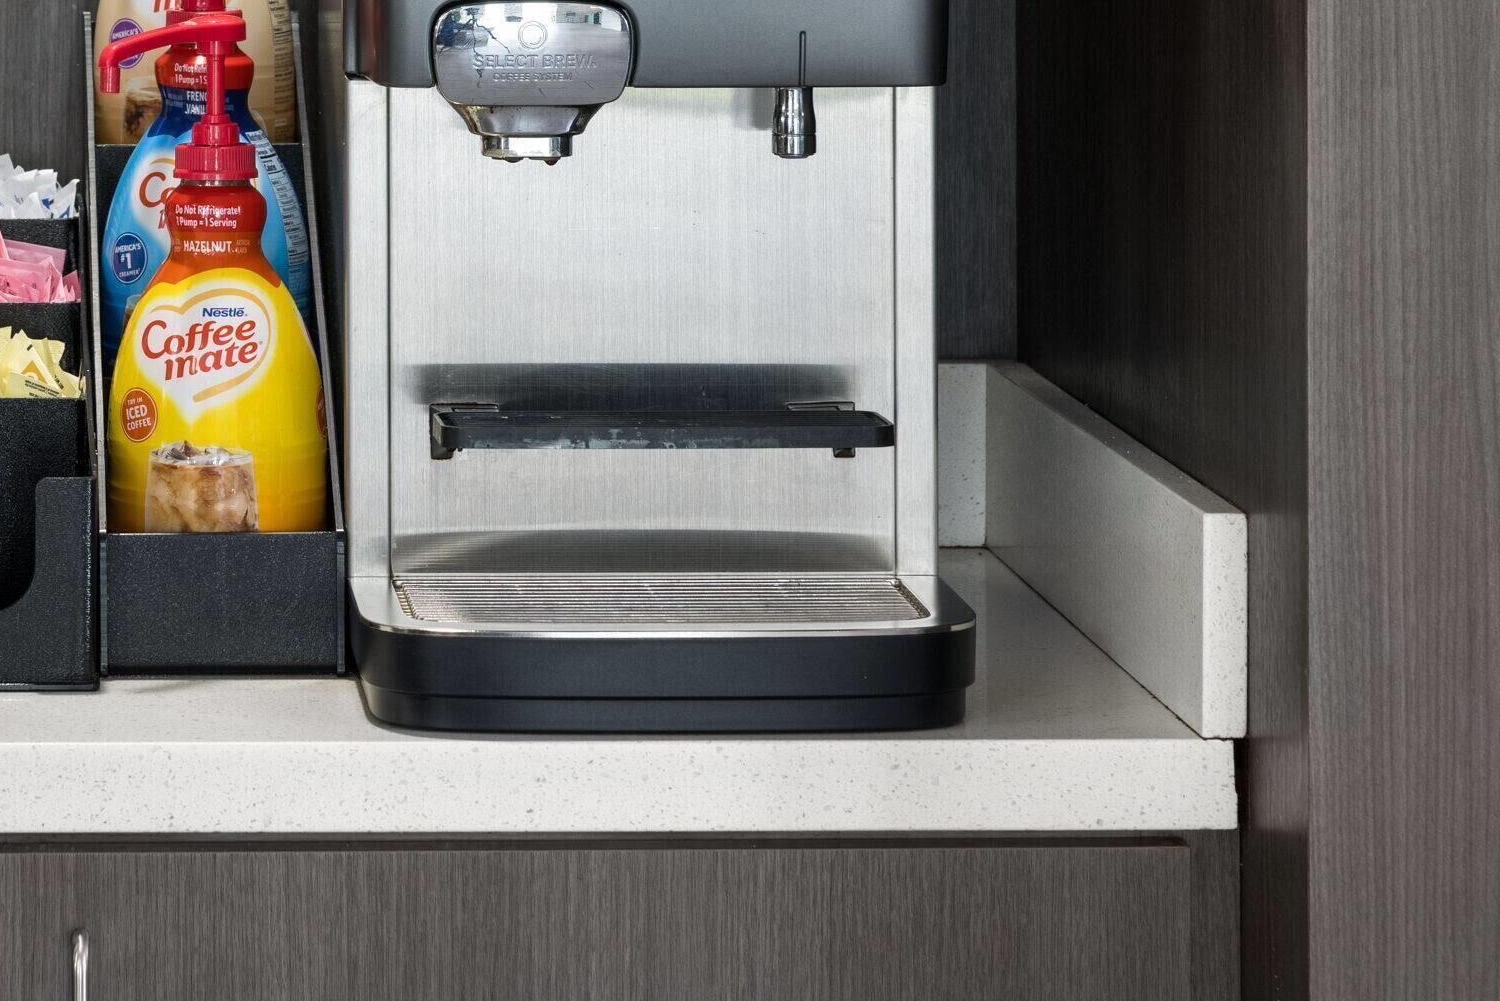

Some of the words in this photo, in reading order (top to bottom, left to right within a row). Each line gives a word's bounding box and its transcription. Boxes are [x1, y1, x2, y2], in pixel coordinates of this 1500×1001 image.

[473, 54, 539, 69] SELECT
[178, 74, 195, 85] Pump
[493, 72, 530, 82] COFFEE
[531, 72, 572, 82] SYSTEM
[175, 204, 183, 214] Do
[184, 204, 197, 215] Not
[180, 216, 198, 228] Pump
[209, 216, 237, 229] Serving
[114, 243, 142, 254] AMERICA'S
[183, 240, 232, 253] HAZELNUT
[202, 307, 245, 318] Nestlé
[141, 319, 256, 359] Coffee
[164, 341, 259, 381] mate
[125, 404, 148, 421] ICED
[126, 417, 152, 431] COFFEE
